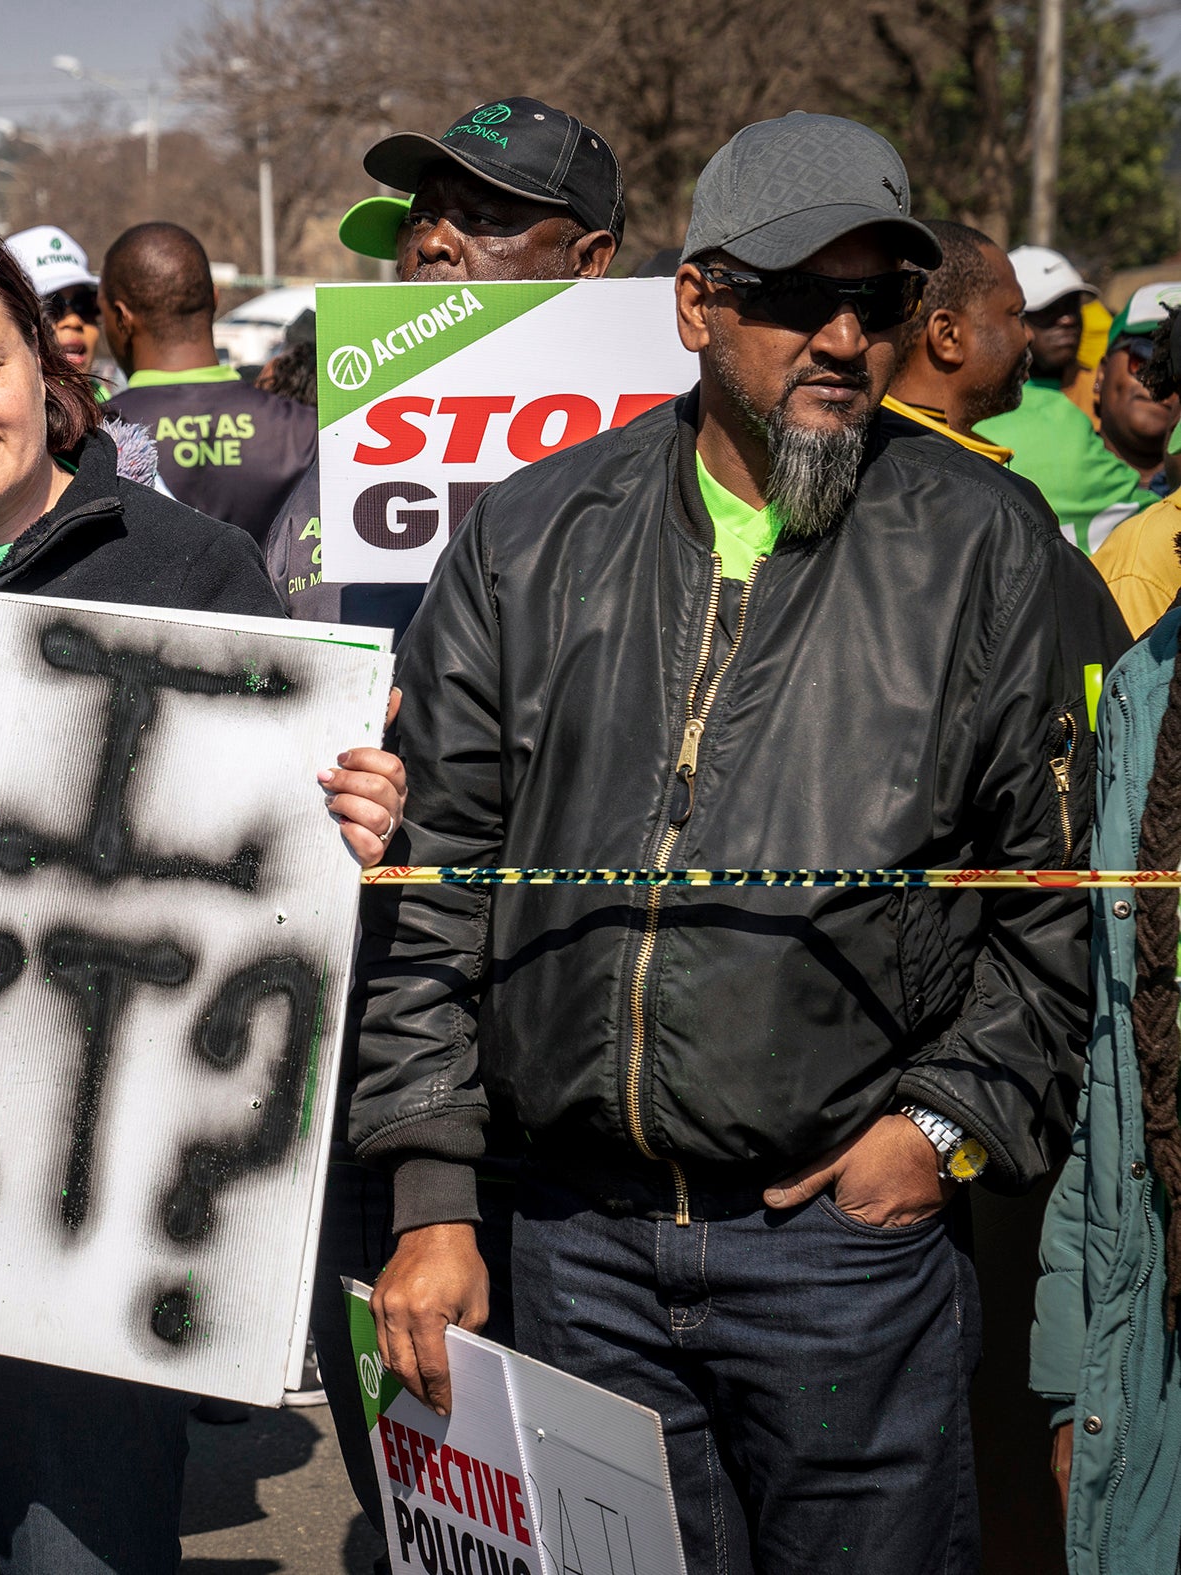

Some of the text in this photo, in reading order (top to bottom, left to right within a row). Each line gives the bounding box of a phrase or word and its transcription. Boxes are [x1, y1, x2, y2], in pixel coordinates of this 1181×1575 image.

[371, 288, 484, 366] ACTIONSA
[156, 413, 256, 441] ACT AS
[173, 440, 242, 468] ONE
[376, 1413, 532, 1547] EFFECTIVE
